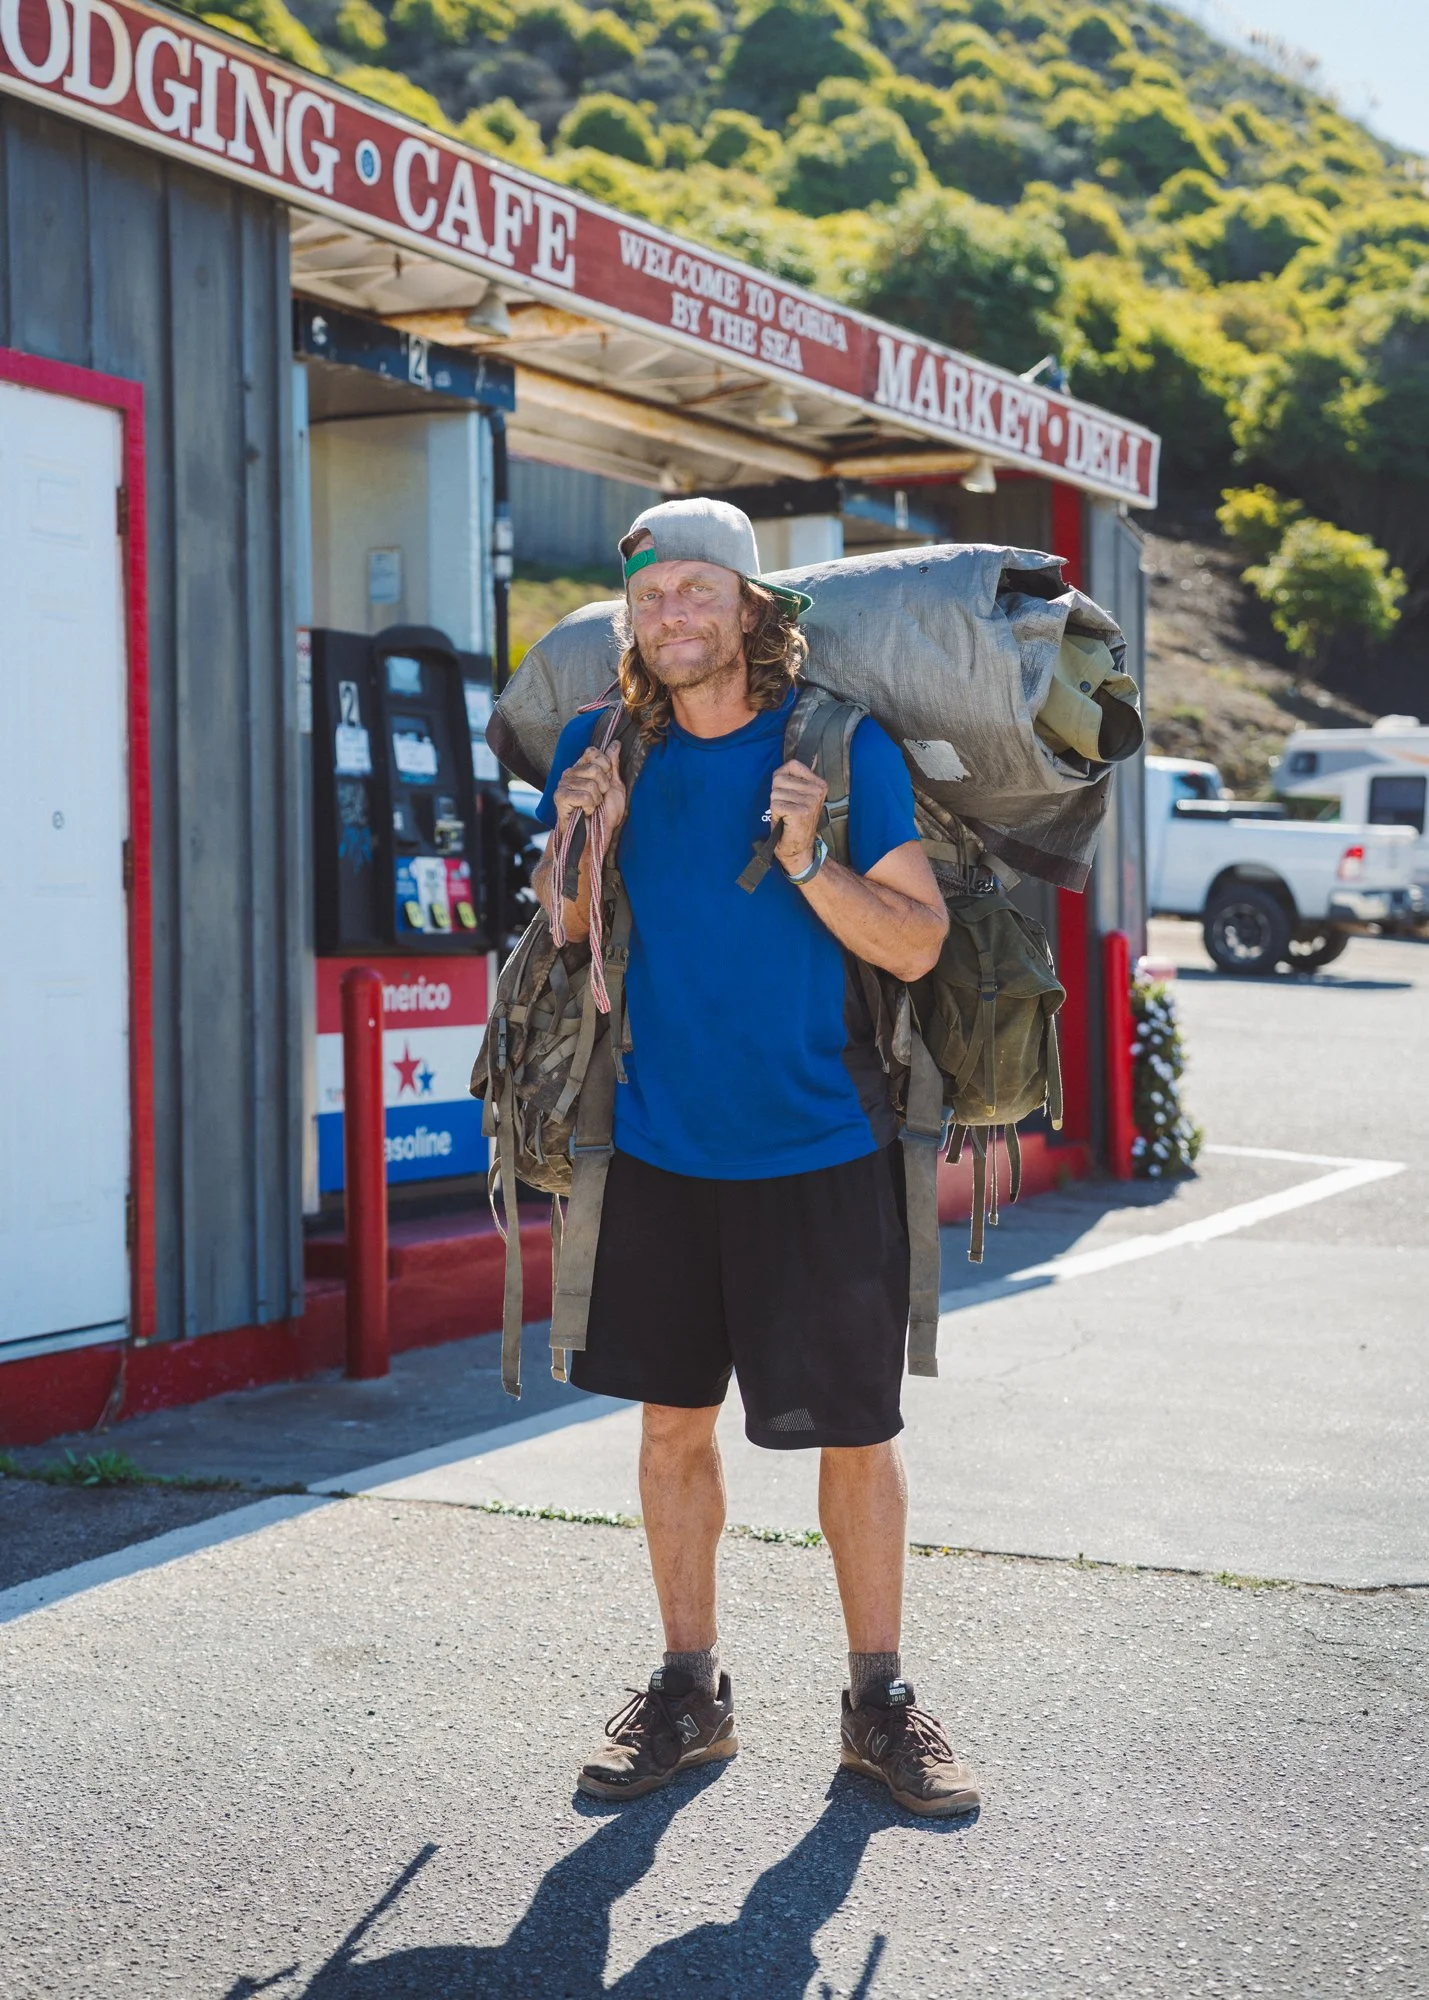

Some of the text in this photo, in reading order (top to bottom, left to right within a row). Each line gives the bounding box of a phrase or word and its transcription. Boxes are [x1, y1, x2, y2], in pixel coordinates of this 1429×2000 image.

[0, 0, 577, 289] ODGING CAFE
[618, 229, 741, 309] WELCOME
[745, 281, 776, 322] TO
[670, 291, 804, 372] BY THE SEA
[874, 335, 1143, 492] MARKET DELI
[382, 975, 452, 1012] merico
[383, 1126, 453, 1163] asoline
